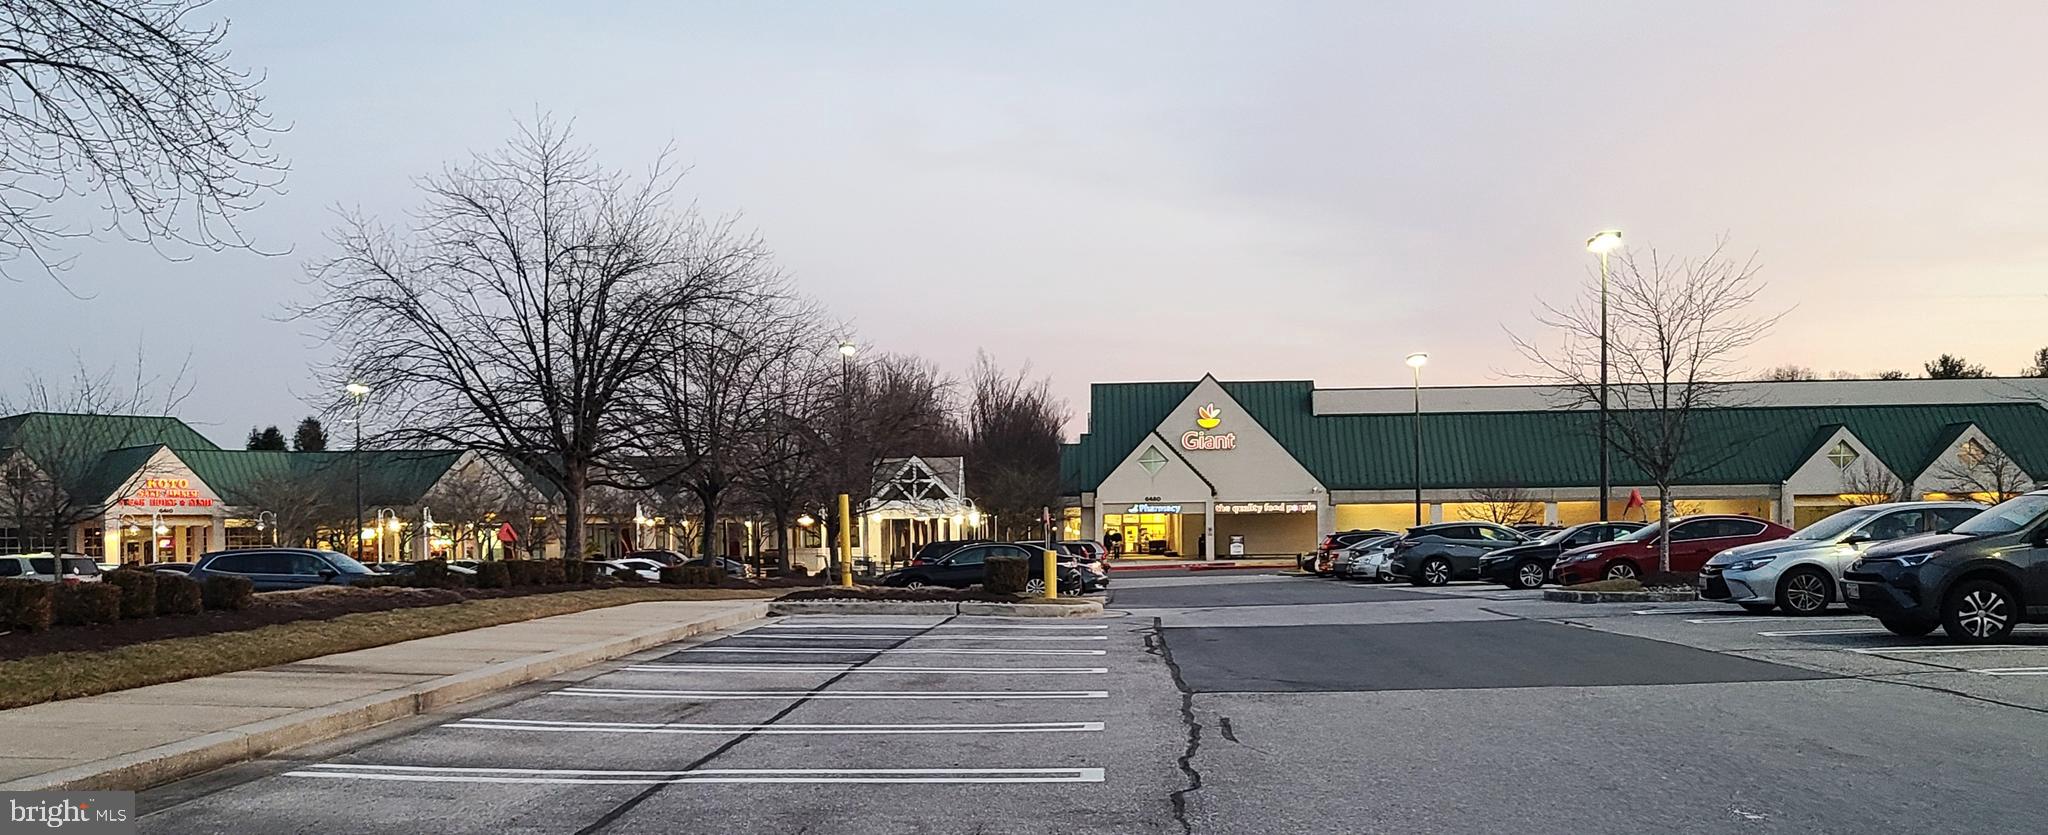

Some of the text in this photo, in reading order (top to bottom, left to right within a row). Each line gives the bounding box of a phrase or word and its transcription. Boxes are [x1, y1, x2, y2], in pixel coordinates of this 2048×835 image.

[1181, 430, 1237, 450] Giant
[146, 479, 189, 489] KOTO
[1139, 503, 1182, 513] Pharmacy
[1215, 503, 1231, 512] the
[1232, 503, 1263, 514] quality
[1264, 502, 1285, 512] food
